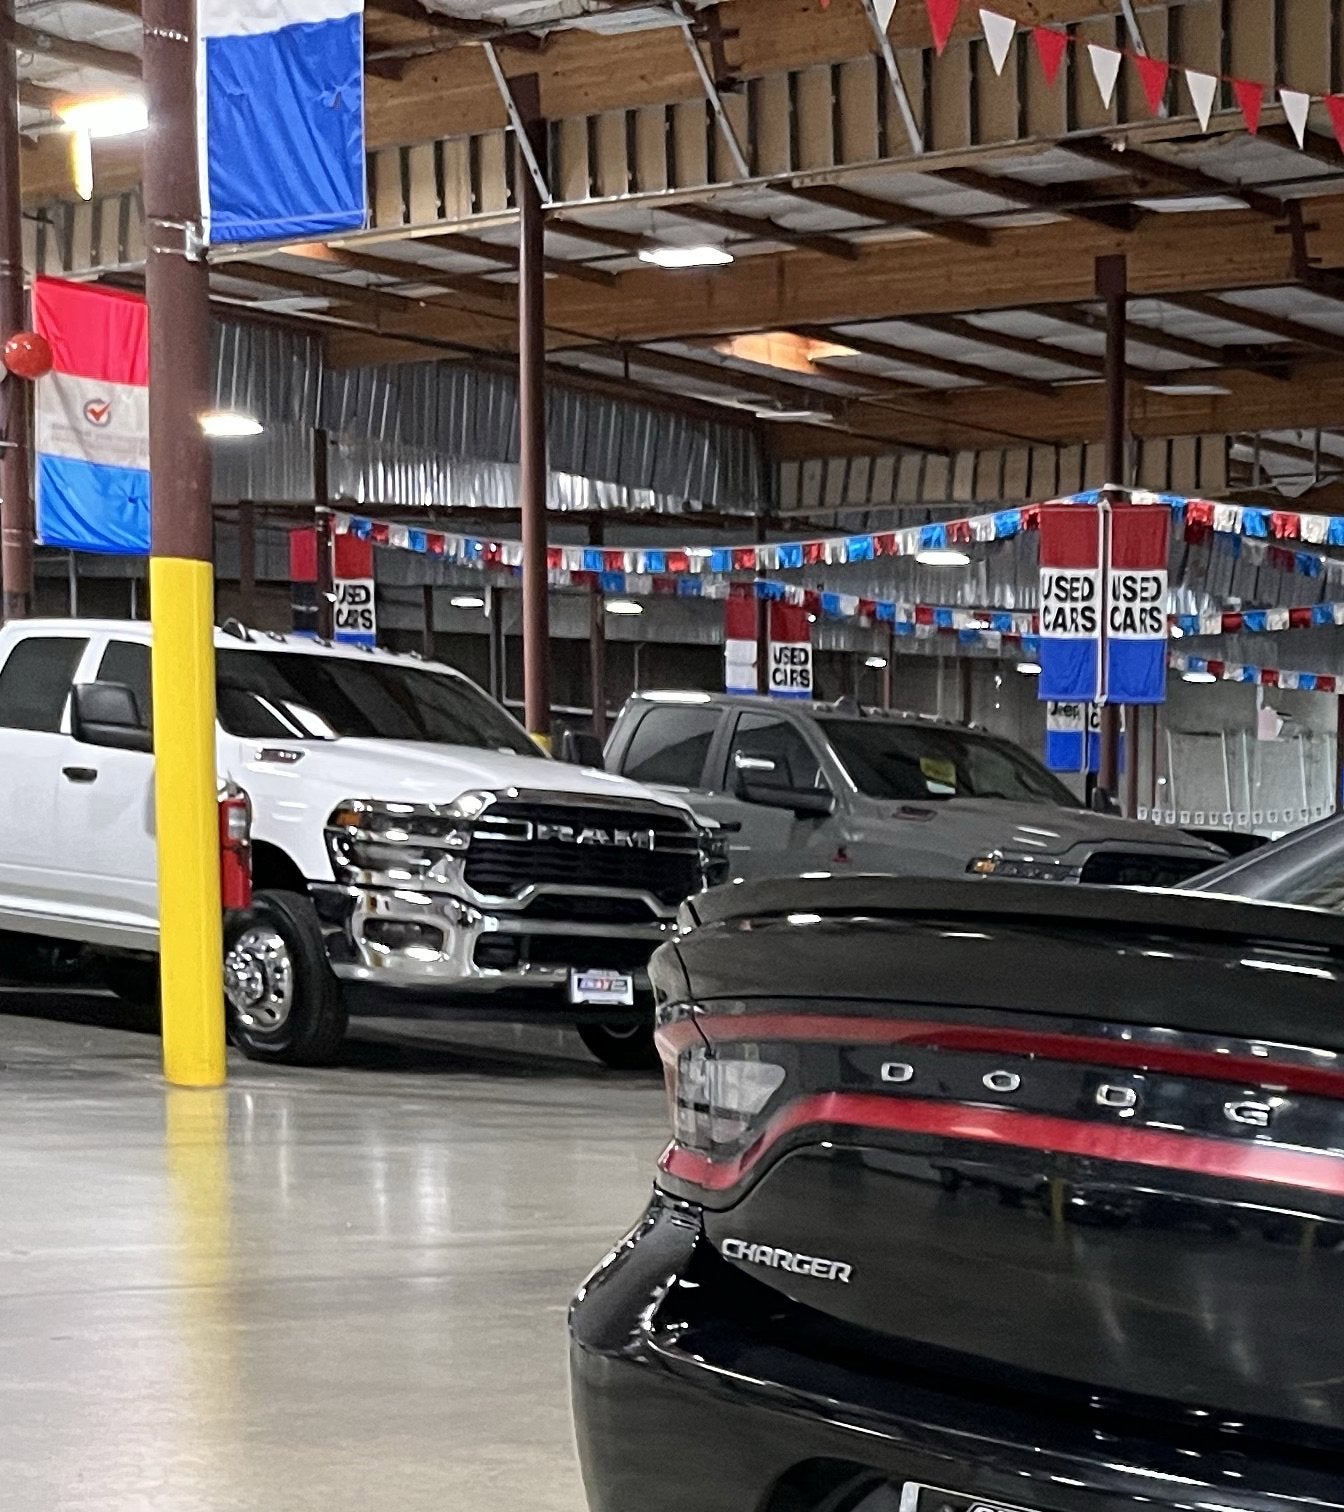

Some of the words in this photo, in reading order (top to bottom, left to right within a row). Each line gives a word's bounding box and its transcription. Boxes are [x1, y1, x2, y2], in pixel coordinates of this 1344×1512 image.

[1042, 574, 1094, 602] USED
[1112, 574, 1162, 602] USED
[1043, 605, 1096, 632] CARS
[1110, 606, 1163, 633] CARS
[773, 646, 810, 666] USED
[537, 823, 650, 850] RAM
[722, 1238, 853, 1283] CHARGER
